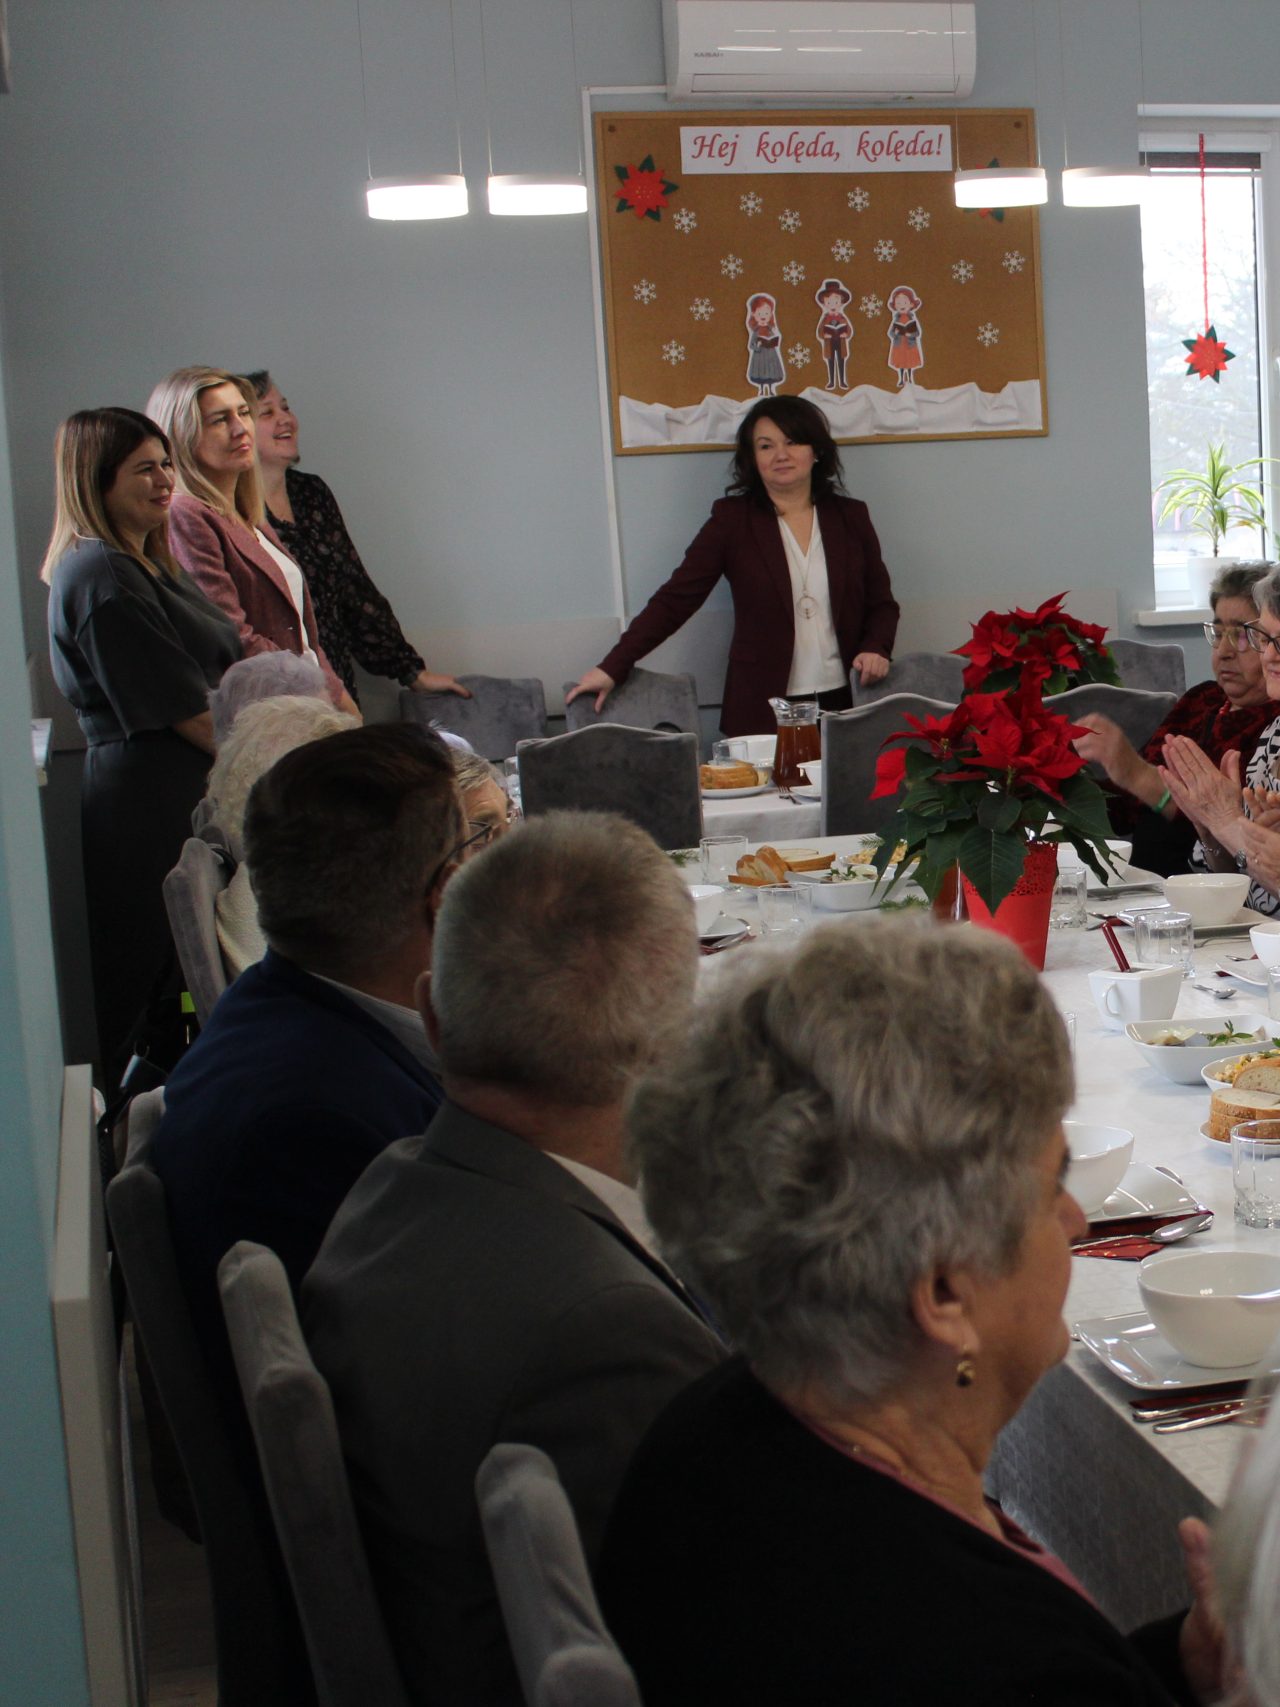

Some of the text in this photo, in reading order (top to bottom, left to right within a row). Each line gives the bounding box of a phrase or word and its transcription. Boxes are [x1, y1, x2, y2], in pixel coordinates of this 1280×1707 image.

[691, 130, 943, 166] Hej kolęda, kolęda!
